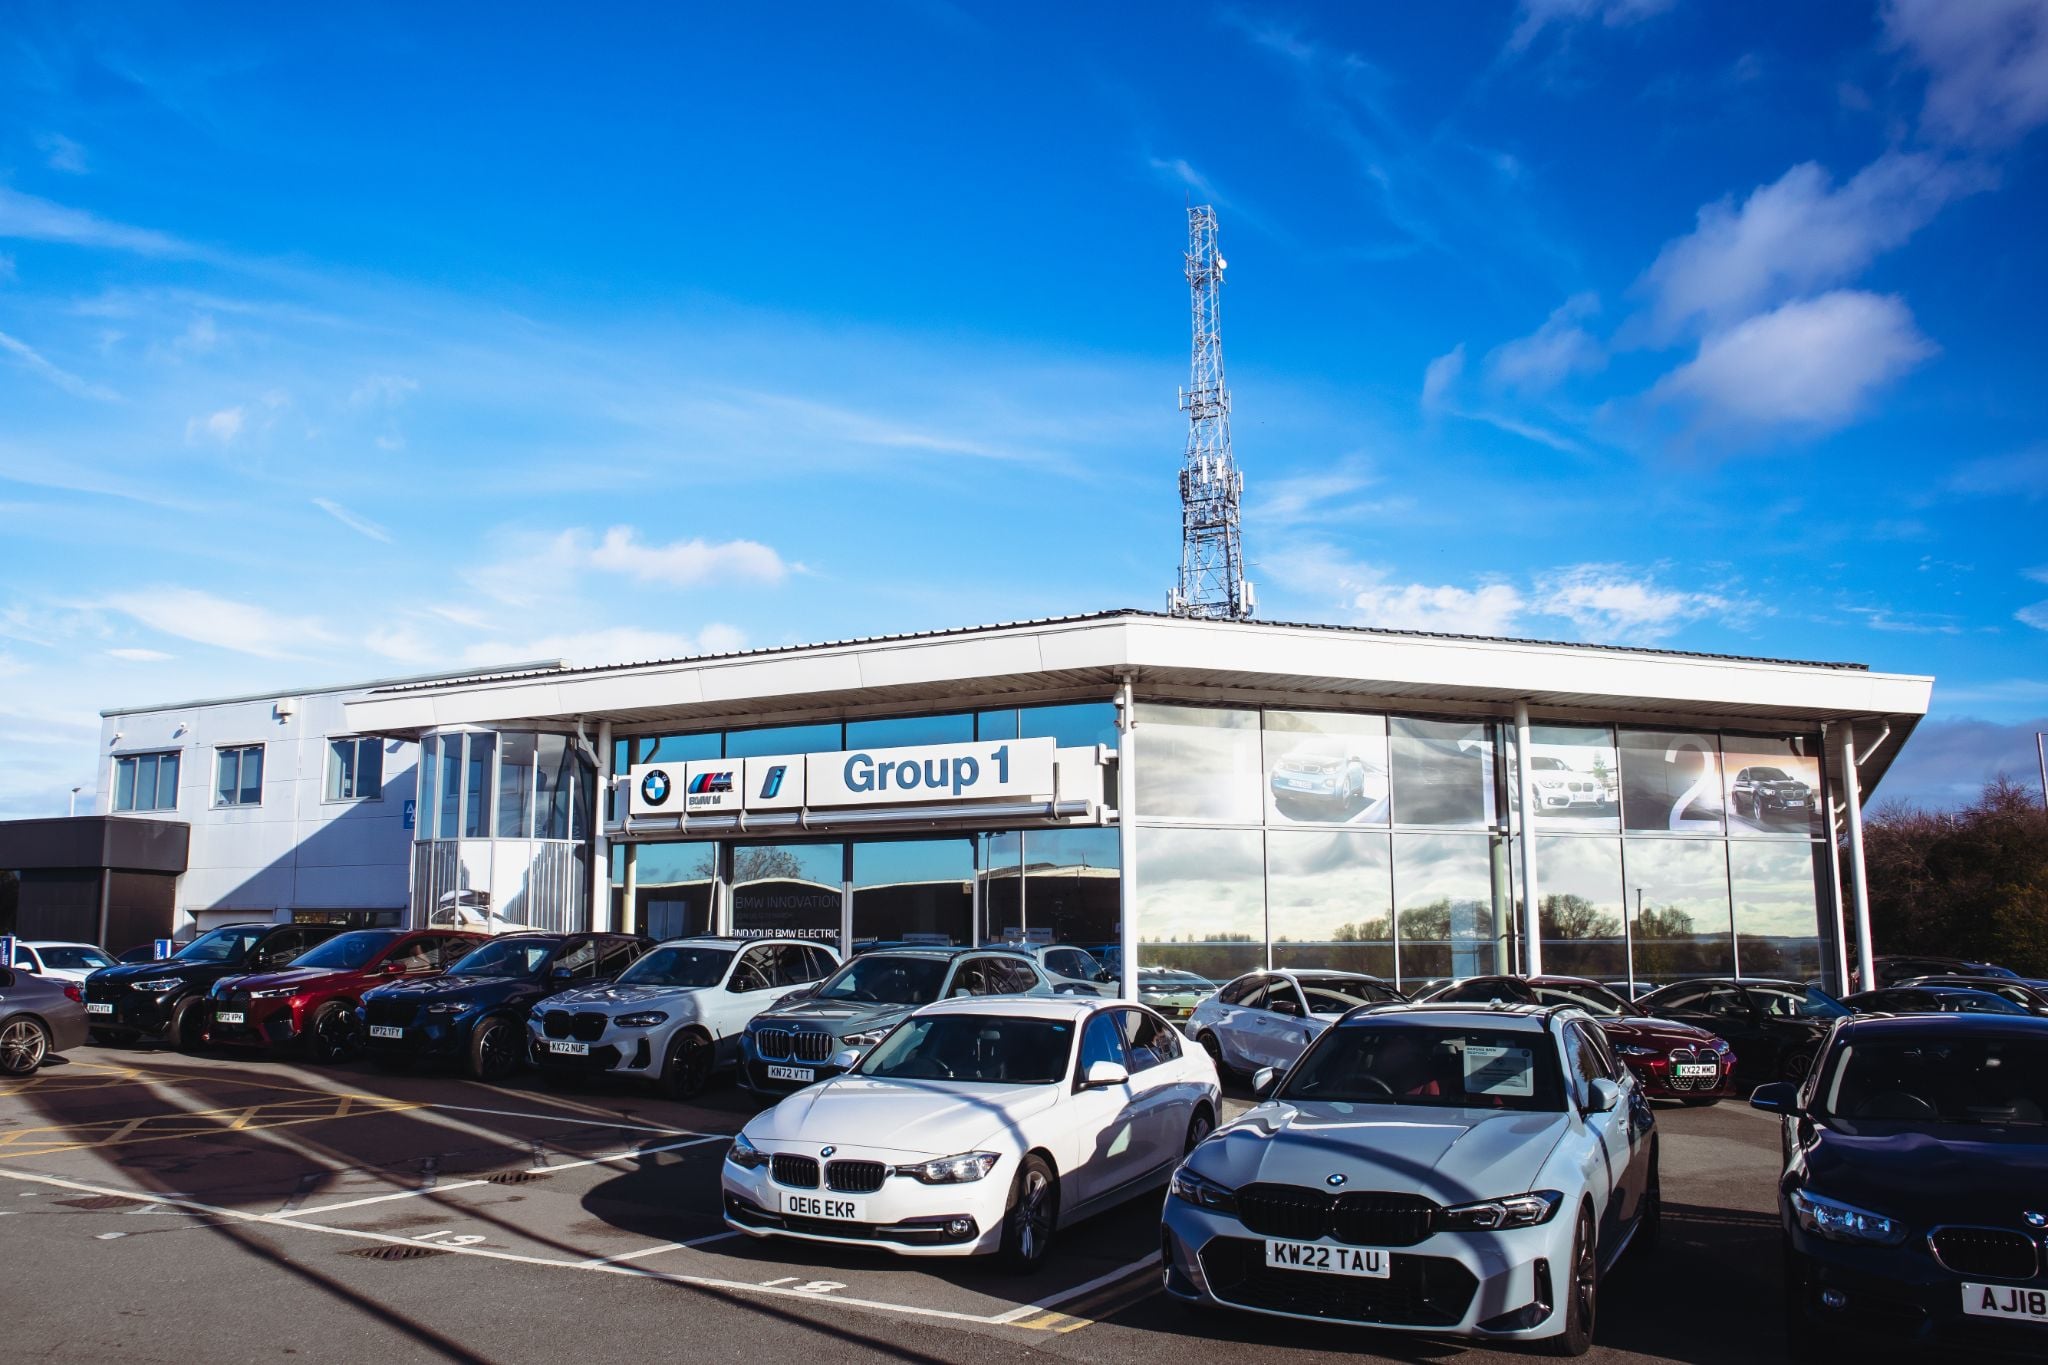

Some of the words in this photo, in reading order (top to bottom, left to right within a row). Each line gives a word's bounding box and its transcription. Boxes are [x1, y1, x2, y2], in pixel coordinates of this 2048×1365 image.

[843, 753, 980, 796] Group
[990, 745, 1009, 784] 1
[688, 795, 712, 806] BMW
[712, 795, 721, 805] M
[735, 896, 764, 909] BMW
[767, 895, 840, 908] INNOVATION
[729, 928, 749, 938] FIND
[749, 928, 773, 938] YOUR
[775, 928, 796, 939] BMW
[797, 928, 840, 939] ELECTRIC
[552, 1041, 570, 1052] KX72
[570, 1043, 585, 1053] NUF
[771, 1066, 792, 1078] KN72
[794, 1069, 810, 1080] VTT
[1681, 1065, 1700, 1074] KX22
[789, 1196, 821, 1215] OE16
[825, 1200, 855, 1218] EKR
[1274, 1242, 1330, 1268] KW22
[1336, 1248, 1380, 1272] TAU
[1981, 1286, 2047, 1315] AJ18
